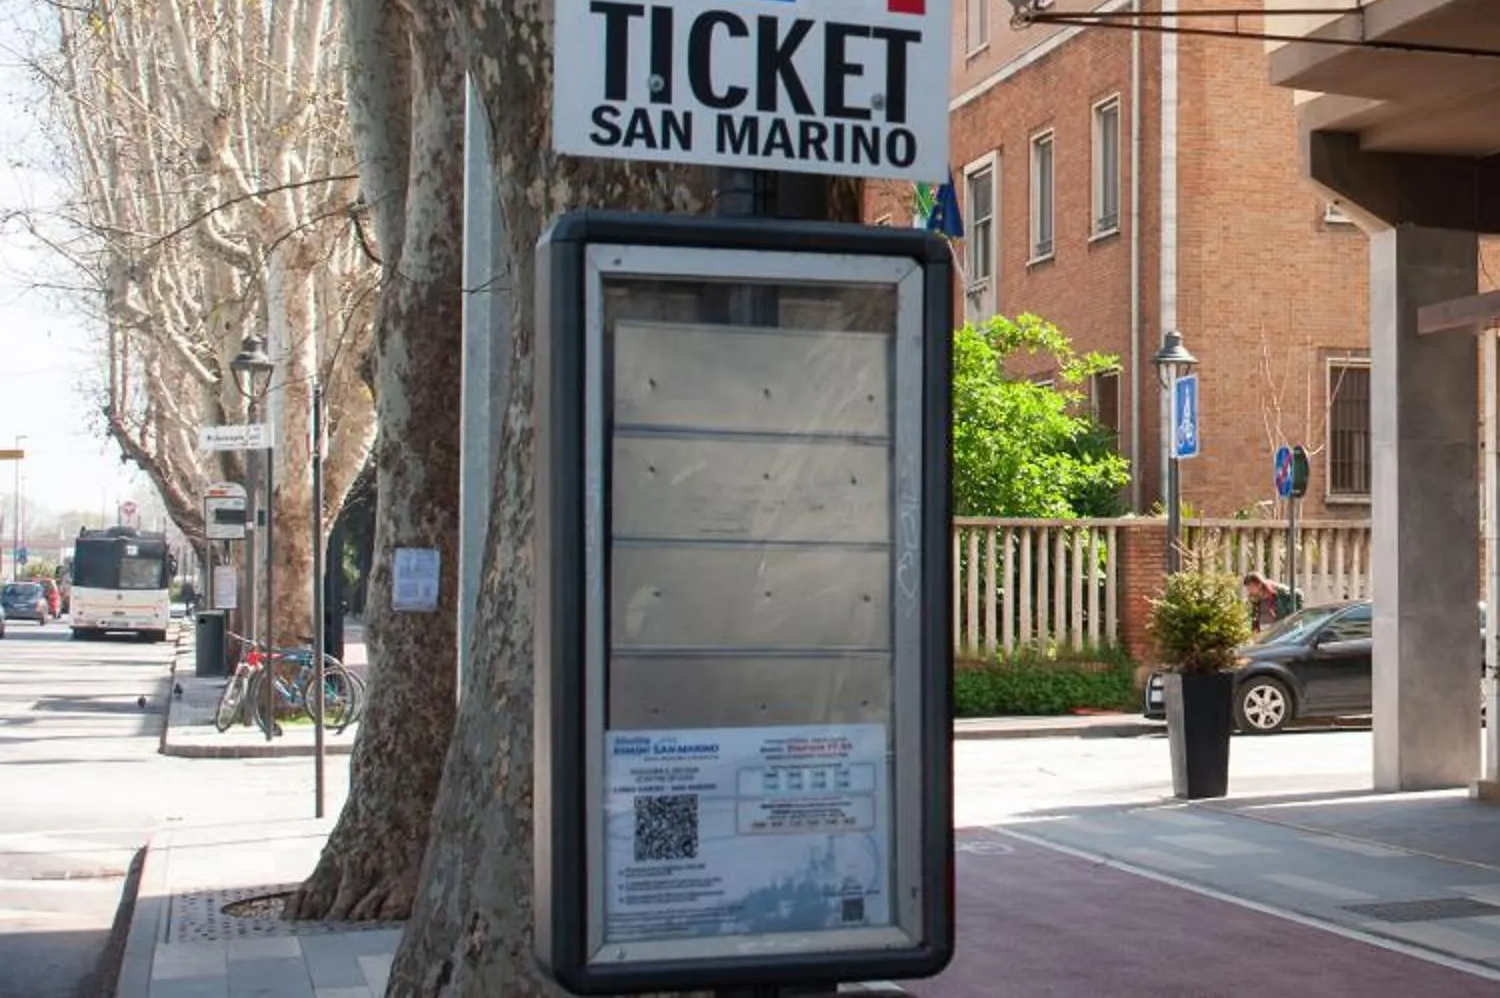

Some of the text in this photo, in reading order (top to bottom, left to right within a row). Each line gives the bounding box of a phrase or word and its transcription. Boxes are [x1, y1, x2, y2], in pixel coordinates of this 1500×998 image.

[589, 0, 922, 124] TICKET
[589, 105, 917, 168] SAN MARINO
